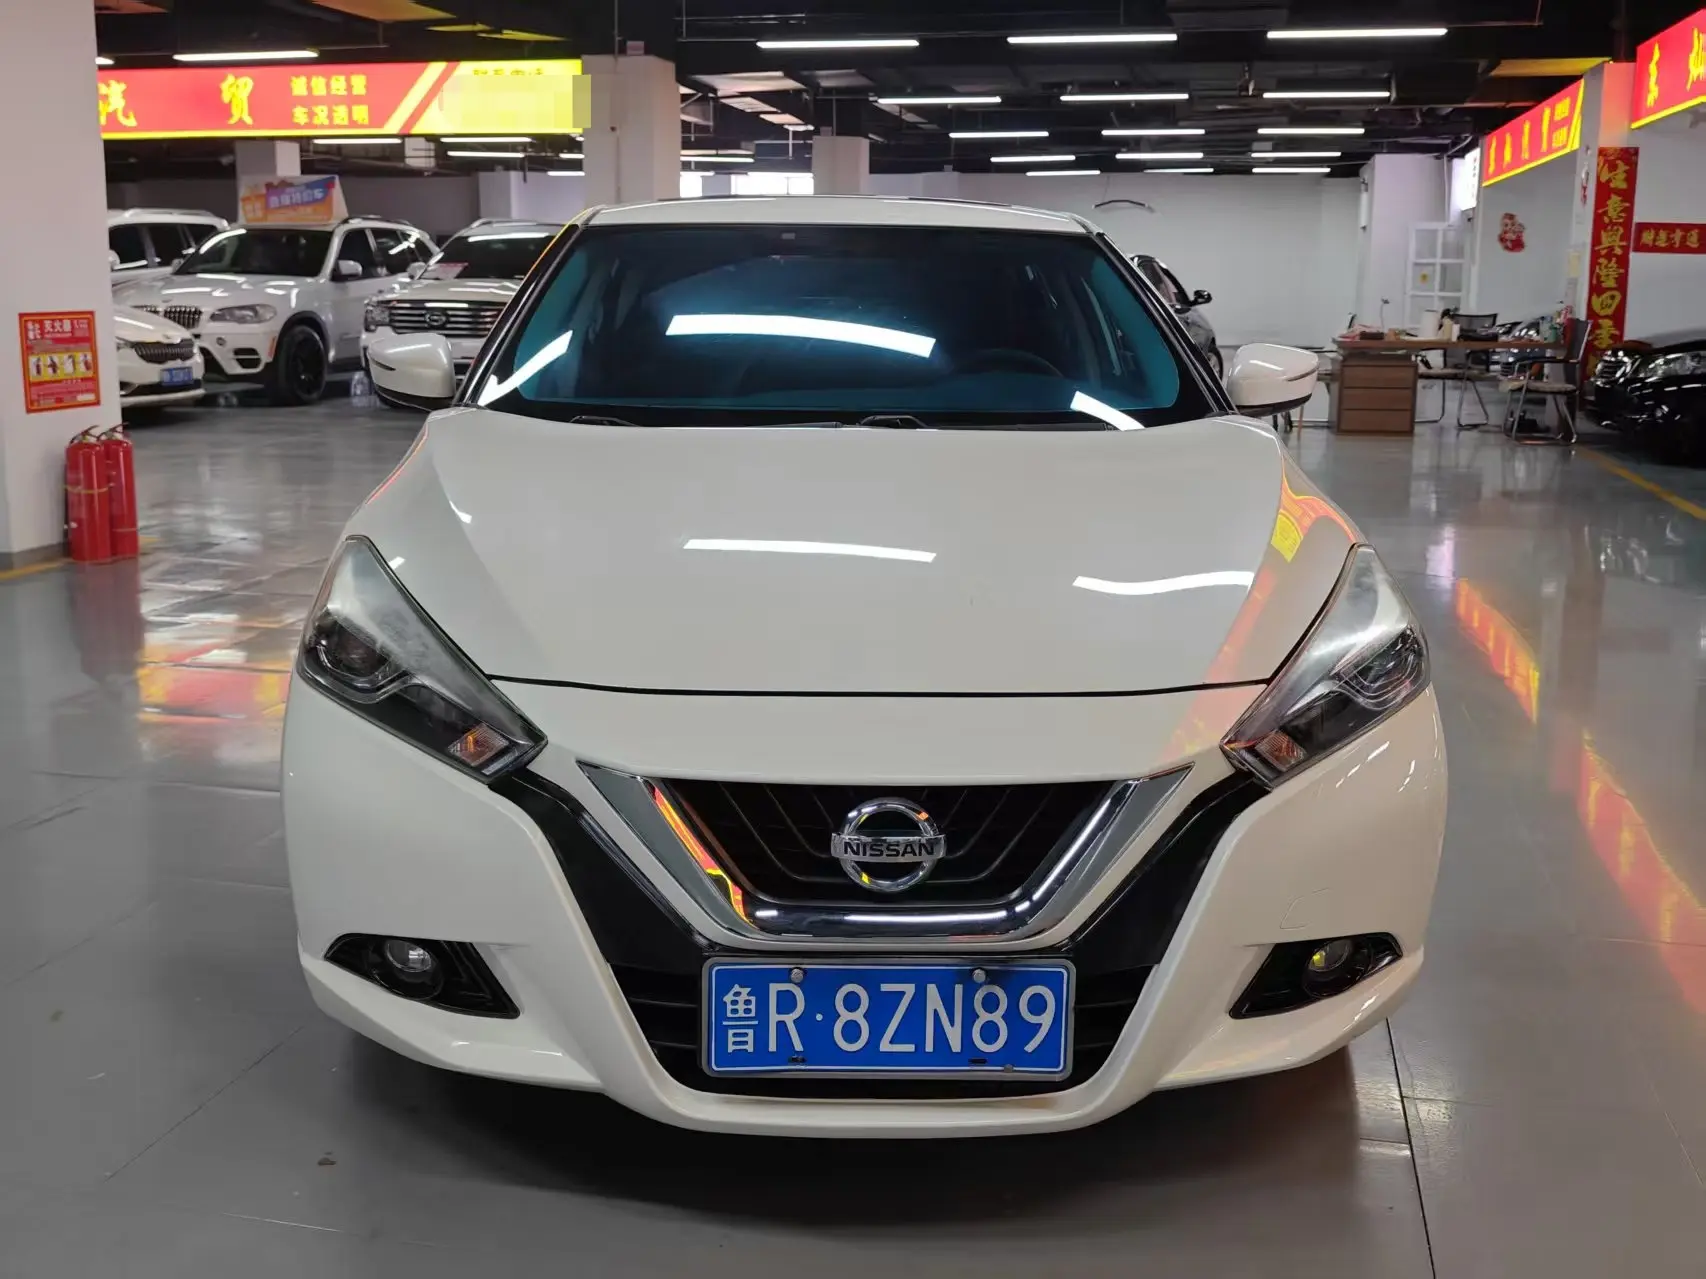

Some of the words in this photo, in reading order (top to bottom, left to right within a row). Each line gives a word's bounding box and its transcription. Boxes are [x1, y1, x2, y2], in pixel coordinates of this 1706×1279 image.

[291, 74, 367, 96] 诚信经营
[292, 104, 369, 126] 车况透明
[1587, 160, 1630, 376] 生意興隆四季
[843, 840, 935, 857] NISSAN
